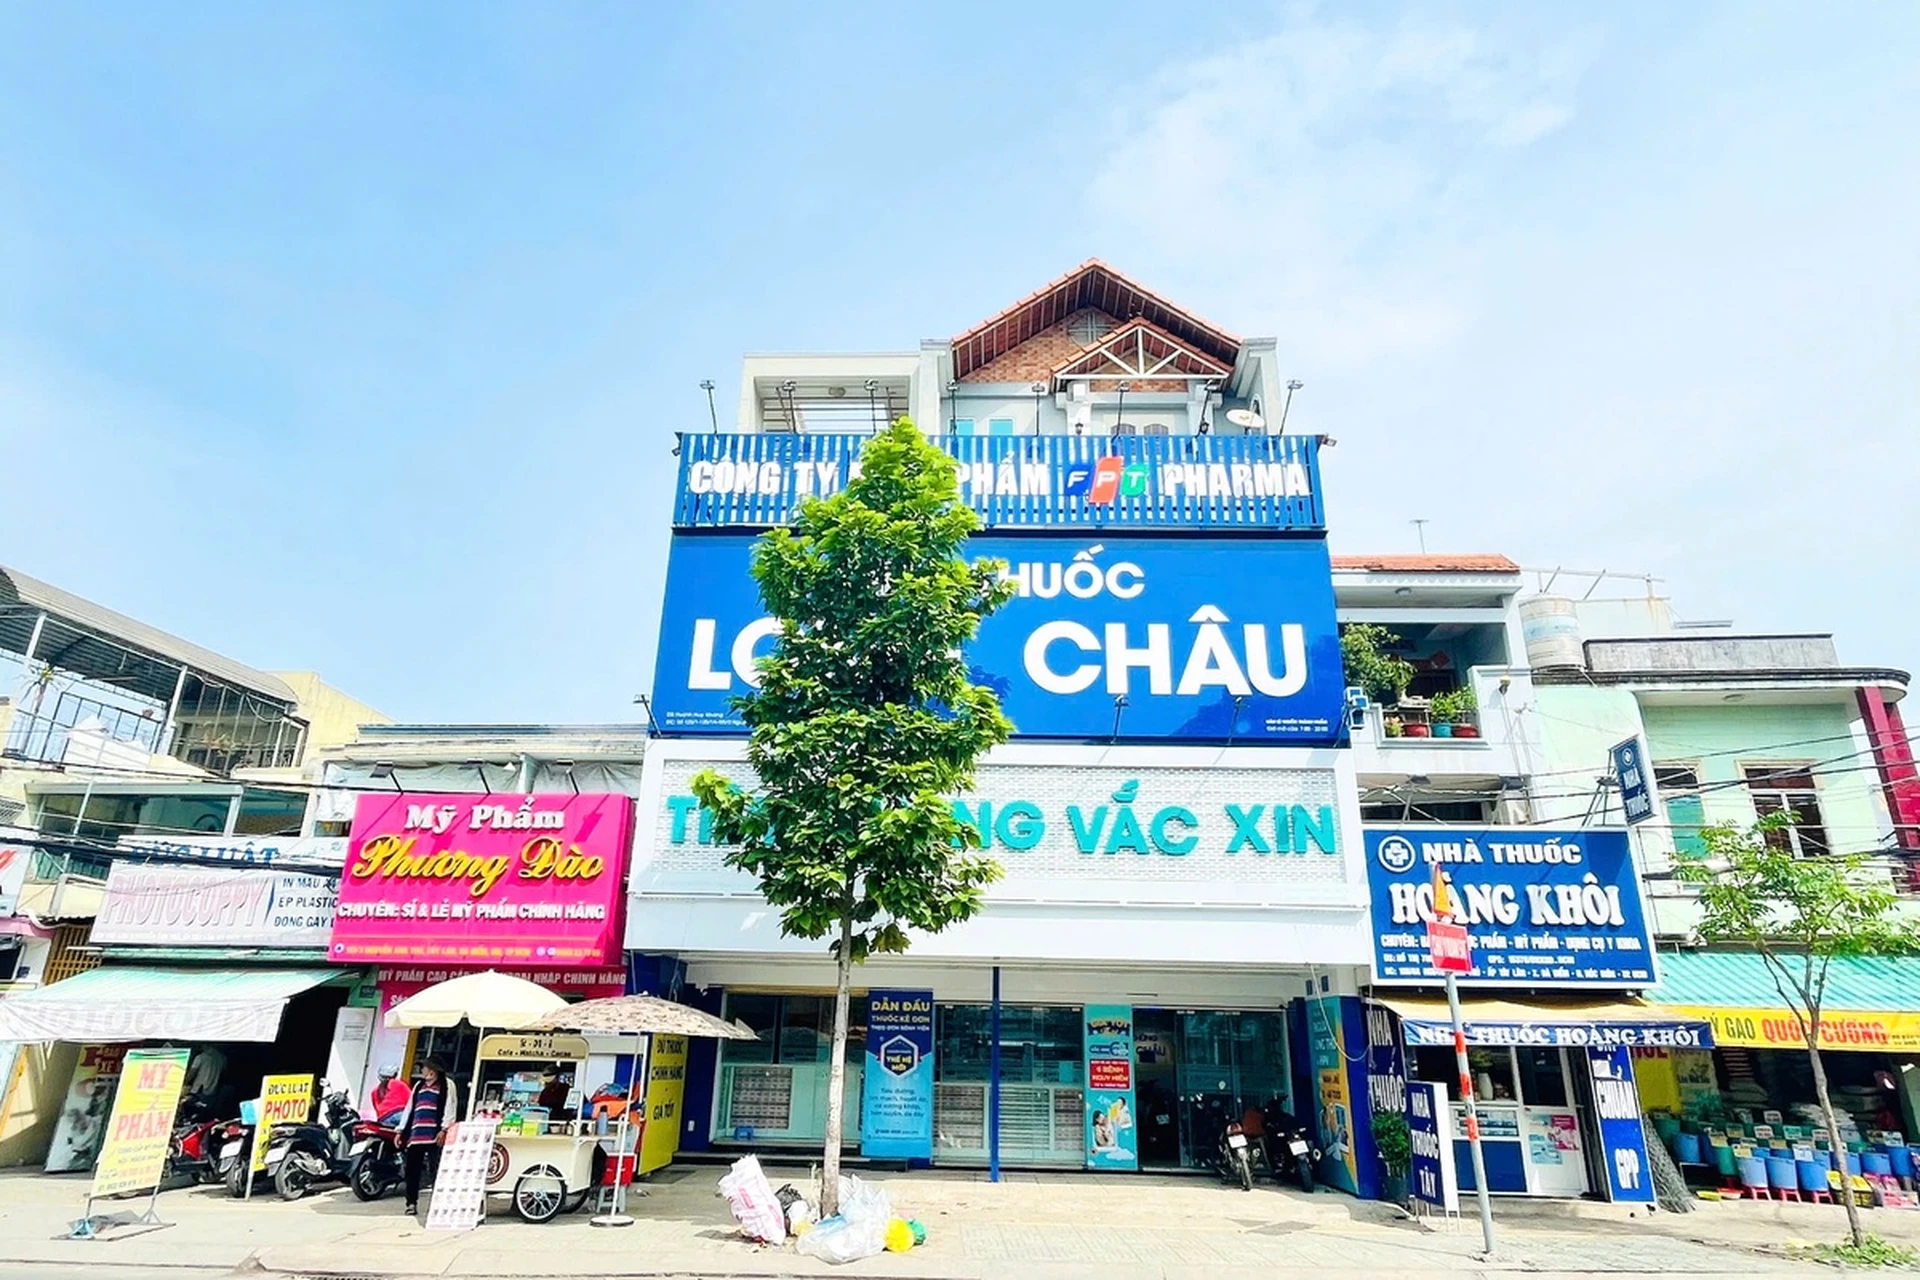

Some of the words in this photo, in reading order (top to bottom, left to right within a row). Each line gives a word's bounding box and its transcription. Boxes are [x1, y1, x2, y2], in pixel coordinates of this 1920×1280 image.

[690, 454, 780, 494] CÔNG
[795, 461, 837, 496] TY
[1163, 462, 1310, 497] PHARMA
[985, 543, 1145, 599] HUỐC
[1024, 603, 1308, 698] CHÂU
[404, 804, 457, 834] Mỹ
[469, 796, 566, 831] Phẩm
[1066, 779, 1200, 856] VẮC
[1224, 804, 1337, 854] XIN
[353, 834, 508, 897] Phương
[518, 836, 604, 879] Đào
[1423, 838, 1483, 863] NHÀ
[1489, 837, 1582, 864] THUỐC
[295, 897, 338, 909] PLASTIC
[338, 902, 398, 919] CHUYÊN:
[418, 904, 428, 918] &
[476, 898, 515, 919] PHẨM
[518, 900, 561, 920] CHÍNH
[1525, 871, 1625, 926] KHÔI
[1638, 1025, 1701, 1046] KHÔI
[264, 1099, 307, 1121] PHOTO
